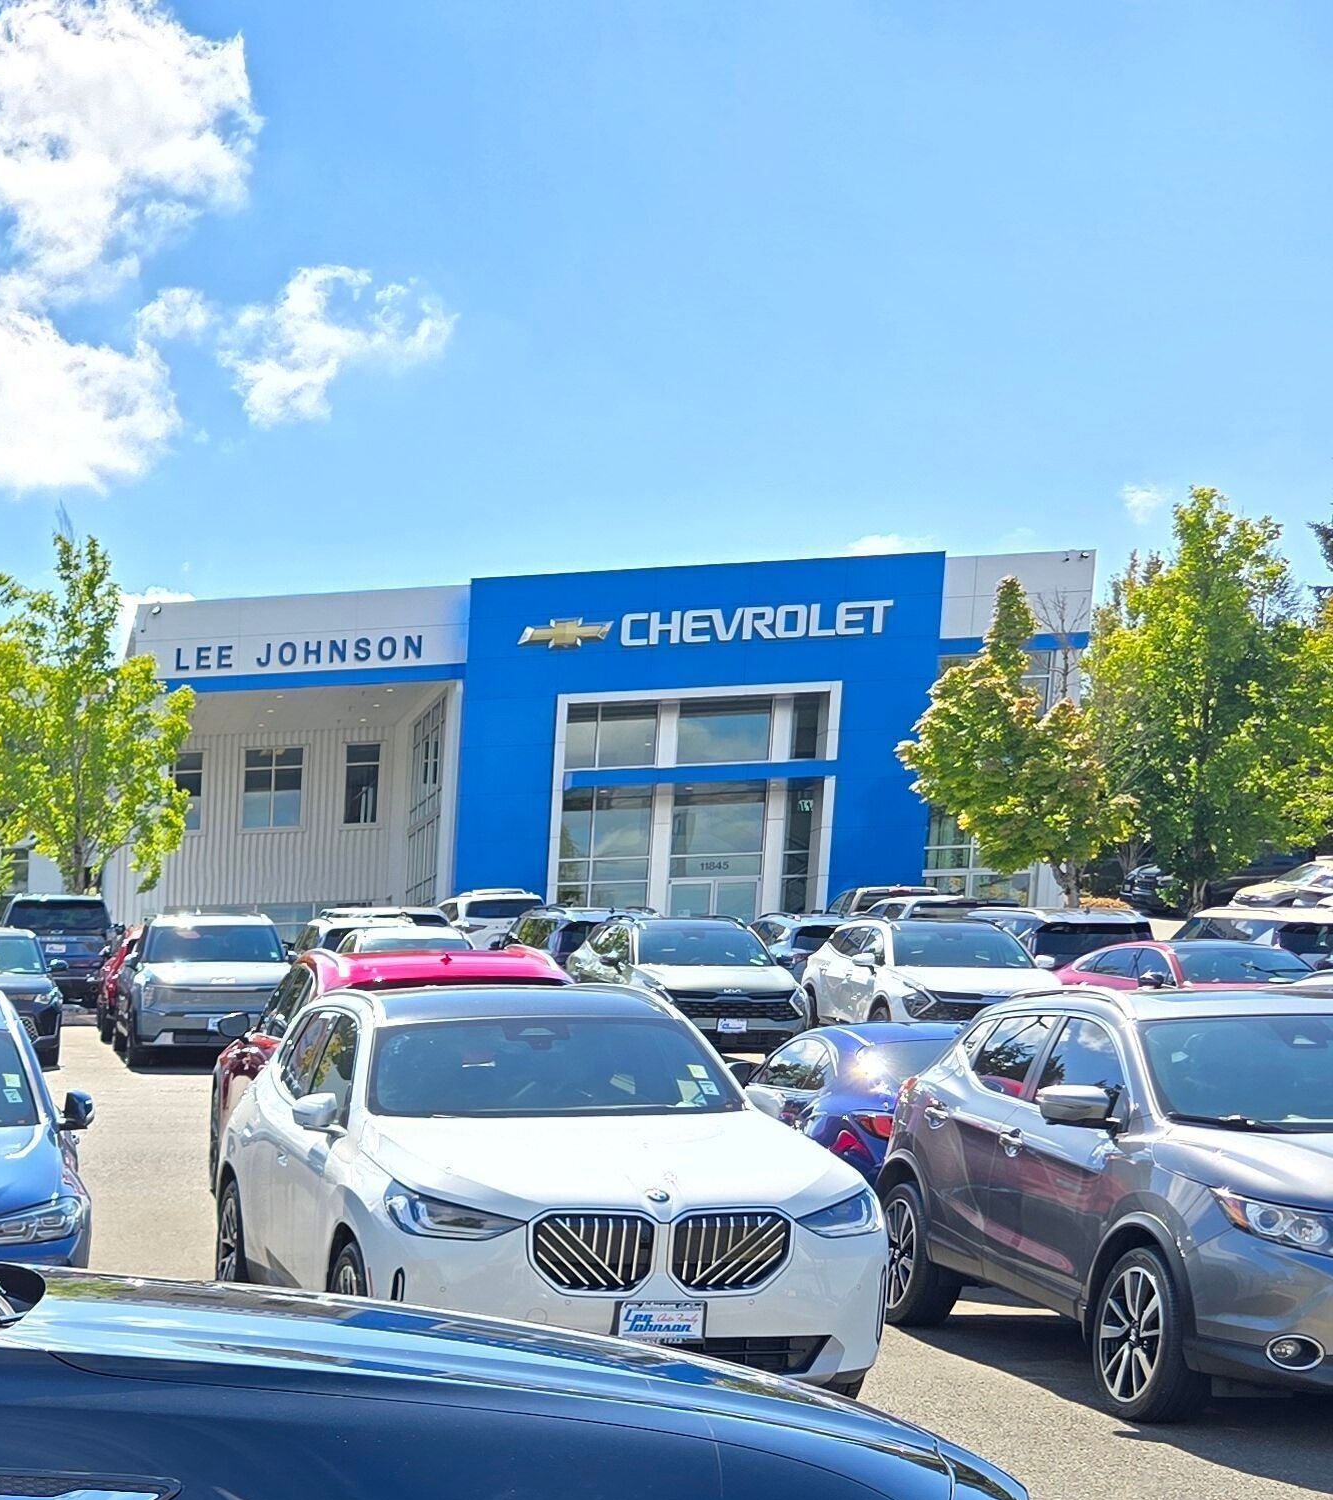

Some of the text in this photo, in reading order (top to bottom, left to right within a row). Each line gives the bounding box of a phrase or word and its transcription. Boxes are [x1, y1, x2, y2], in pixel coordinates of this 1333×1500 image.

[620, 599, 894, 647] CHEVROLET
[175, 634, 424, 671] LEE JOHNSON
[700, 861, 729, 871] 11845
[622, 1309, 653, 1322] Lee
[623, 1320, 693, 1332] Johnson
